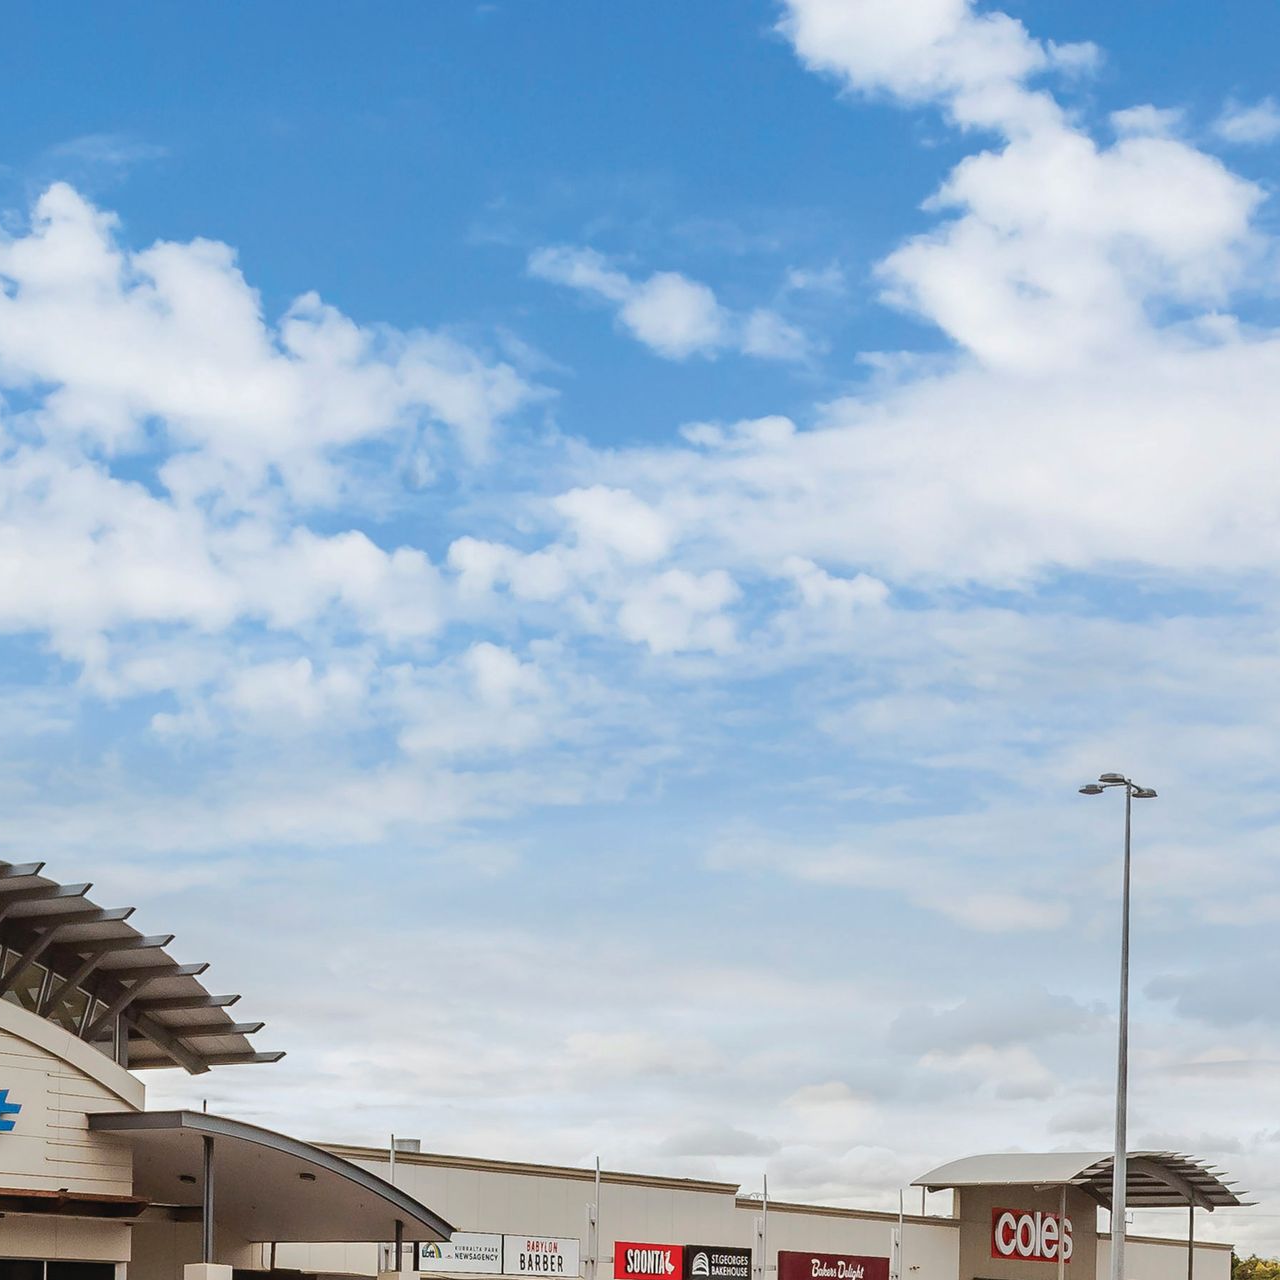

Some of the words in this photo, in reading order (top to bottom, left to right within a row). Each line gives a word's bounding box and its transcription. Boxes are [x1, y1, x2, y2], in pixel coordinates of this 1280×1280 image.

[995, 1211, 1073, 1260] coles
[526, 1240, 558, 1253] BABYLON
[454, 1252, 499, 1262] NEWSAGENCY
[520, 1253, 563, 1273] BARBER
[626, 1248, 665, 1275] SOONTA
[711, 1266, 748, 1277] BAKEHOUSE
[811, 1258, 837, 1278] Bakers
